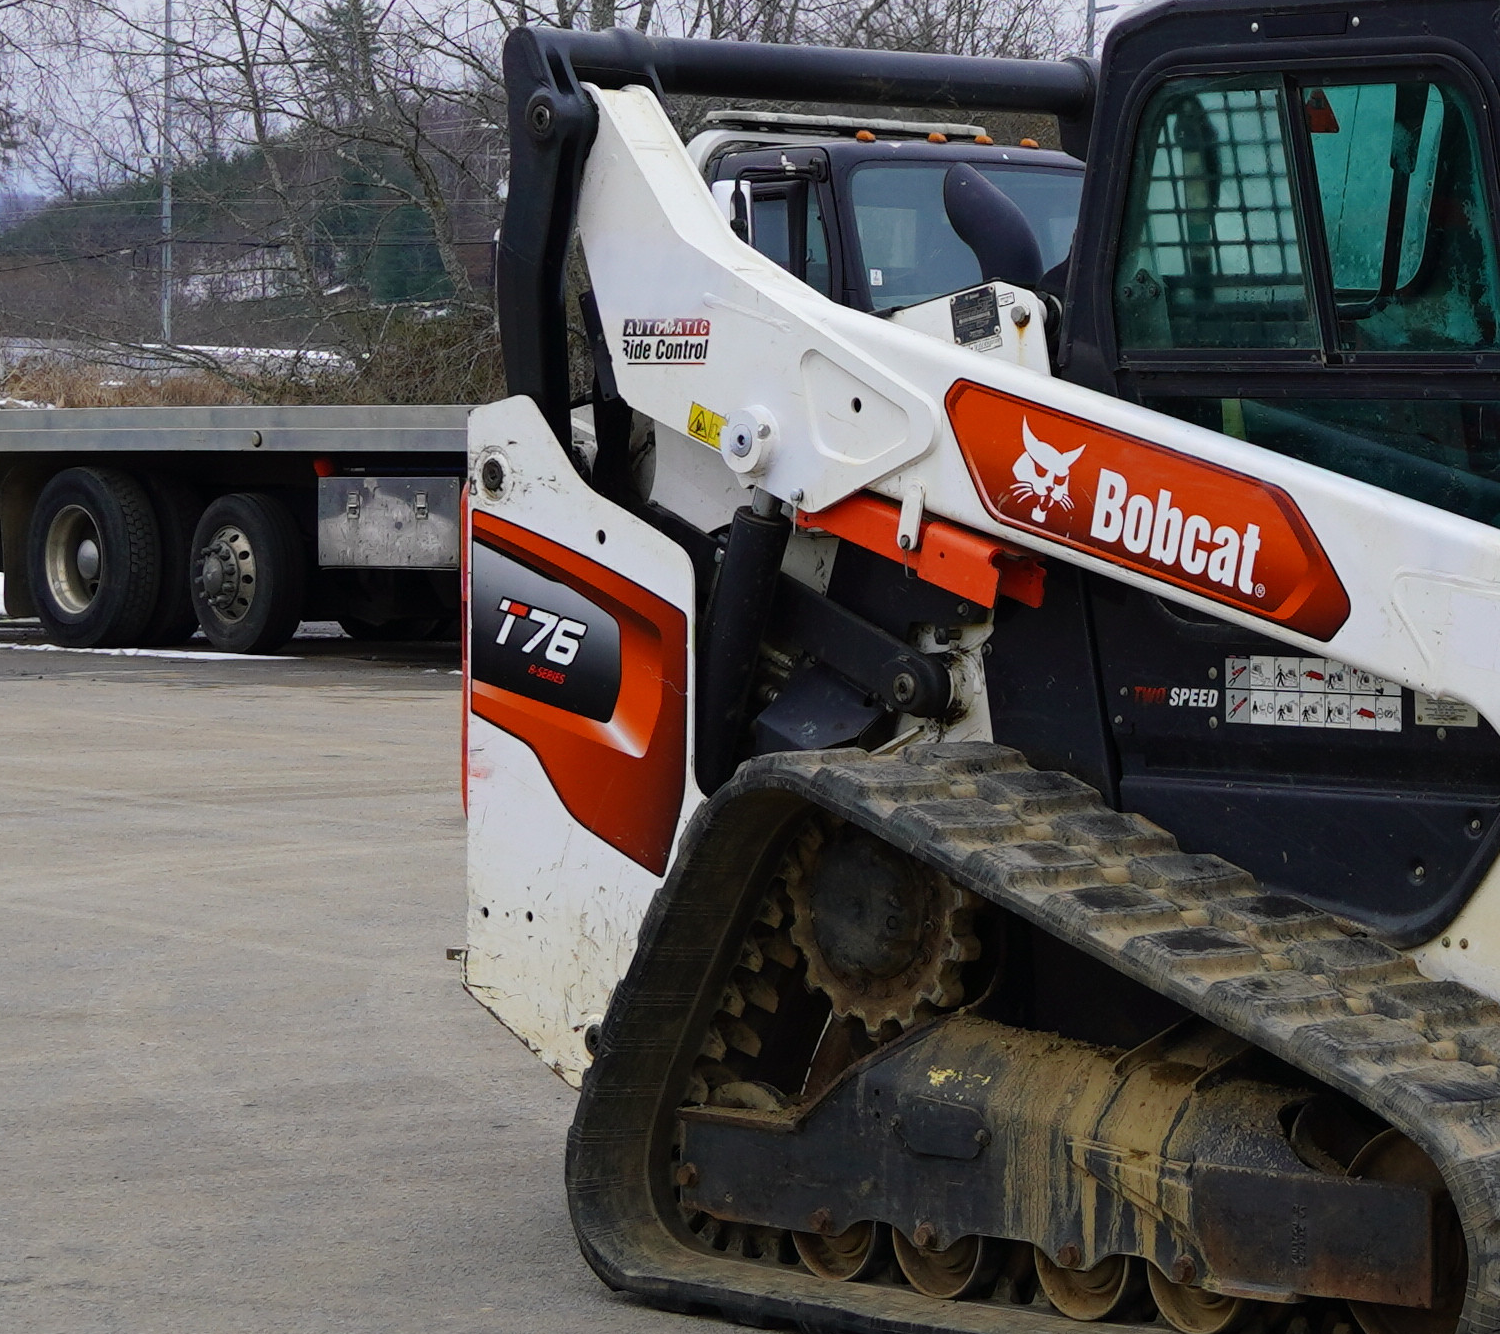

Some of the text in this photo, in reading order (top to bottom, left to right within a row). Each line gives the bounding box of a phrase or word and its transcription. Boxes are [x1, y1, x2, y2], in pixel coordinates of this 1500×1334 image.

[623, 338, 709, 359] Ride Control
[1090, 467, 1261, 595] Bobcat
[496, 598, 588, 666] T76
[1134, 686, 1219, 708] TWO SPEED
